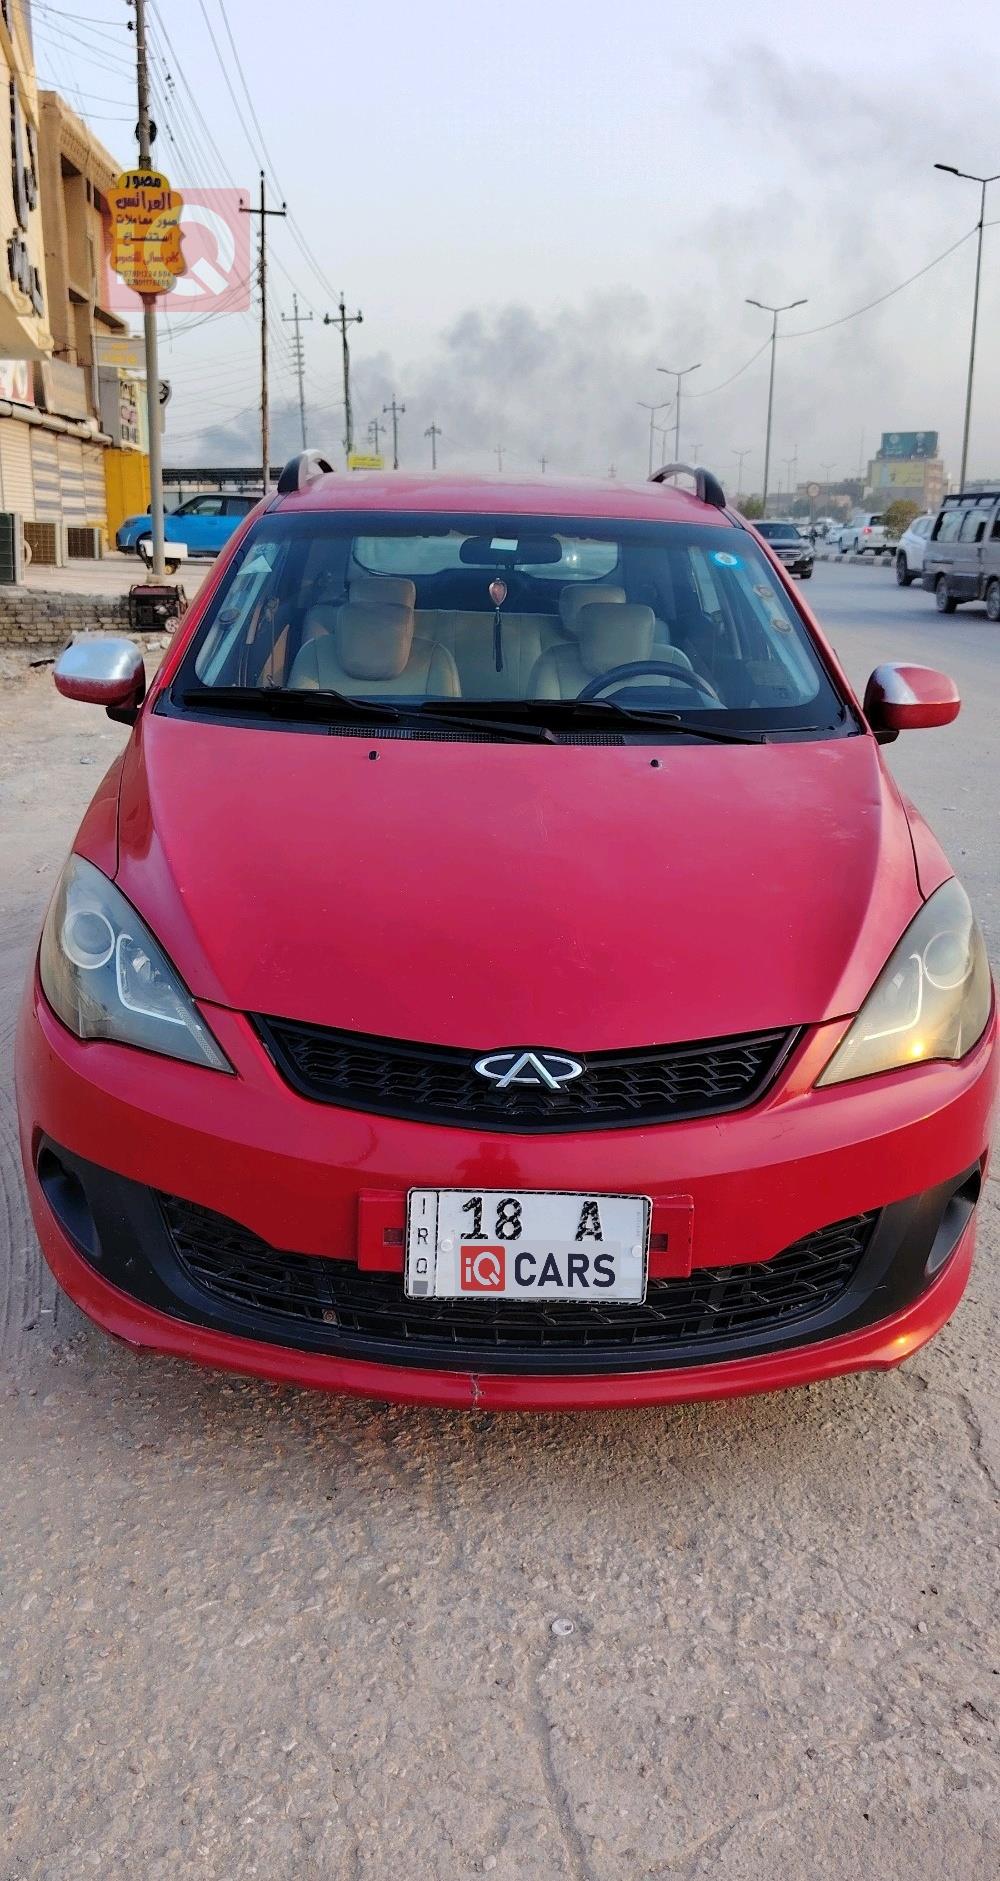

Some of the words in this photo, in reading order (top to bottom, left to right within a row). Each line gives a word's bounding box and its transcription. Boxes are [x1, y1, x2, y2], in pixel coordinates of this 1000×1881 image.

[125, 176, 161, 189] مصور
[460, 1196, 523, 1241] 18
[575, 1200, 604, 1242] A
